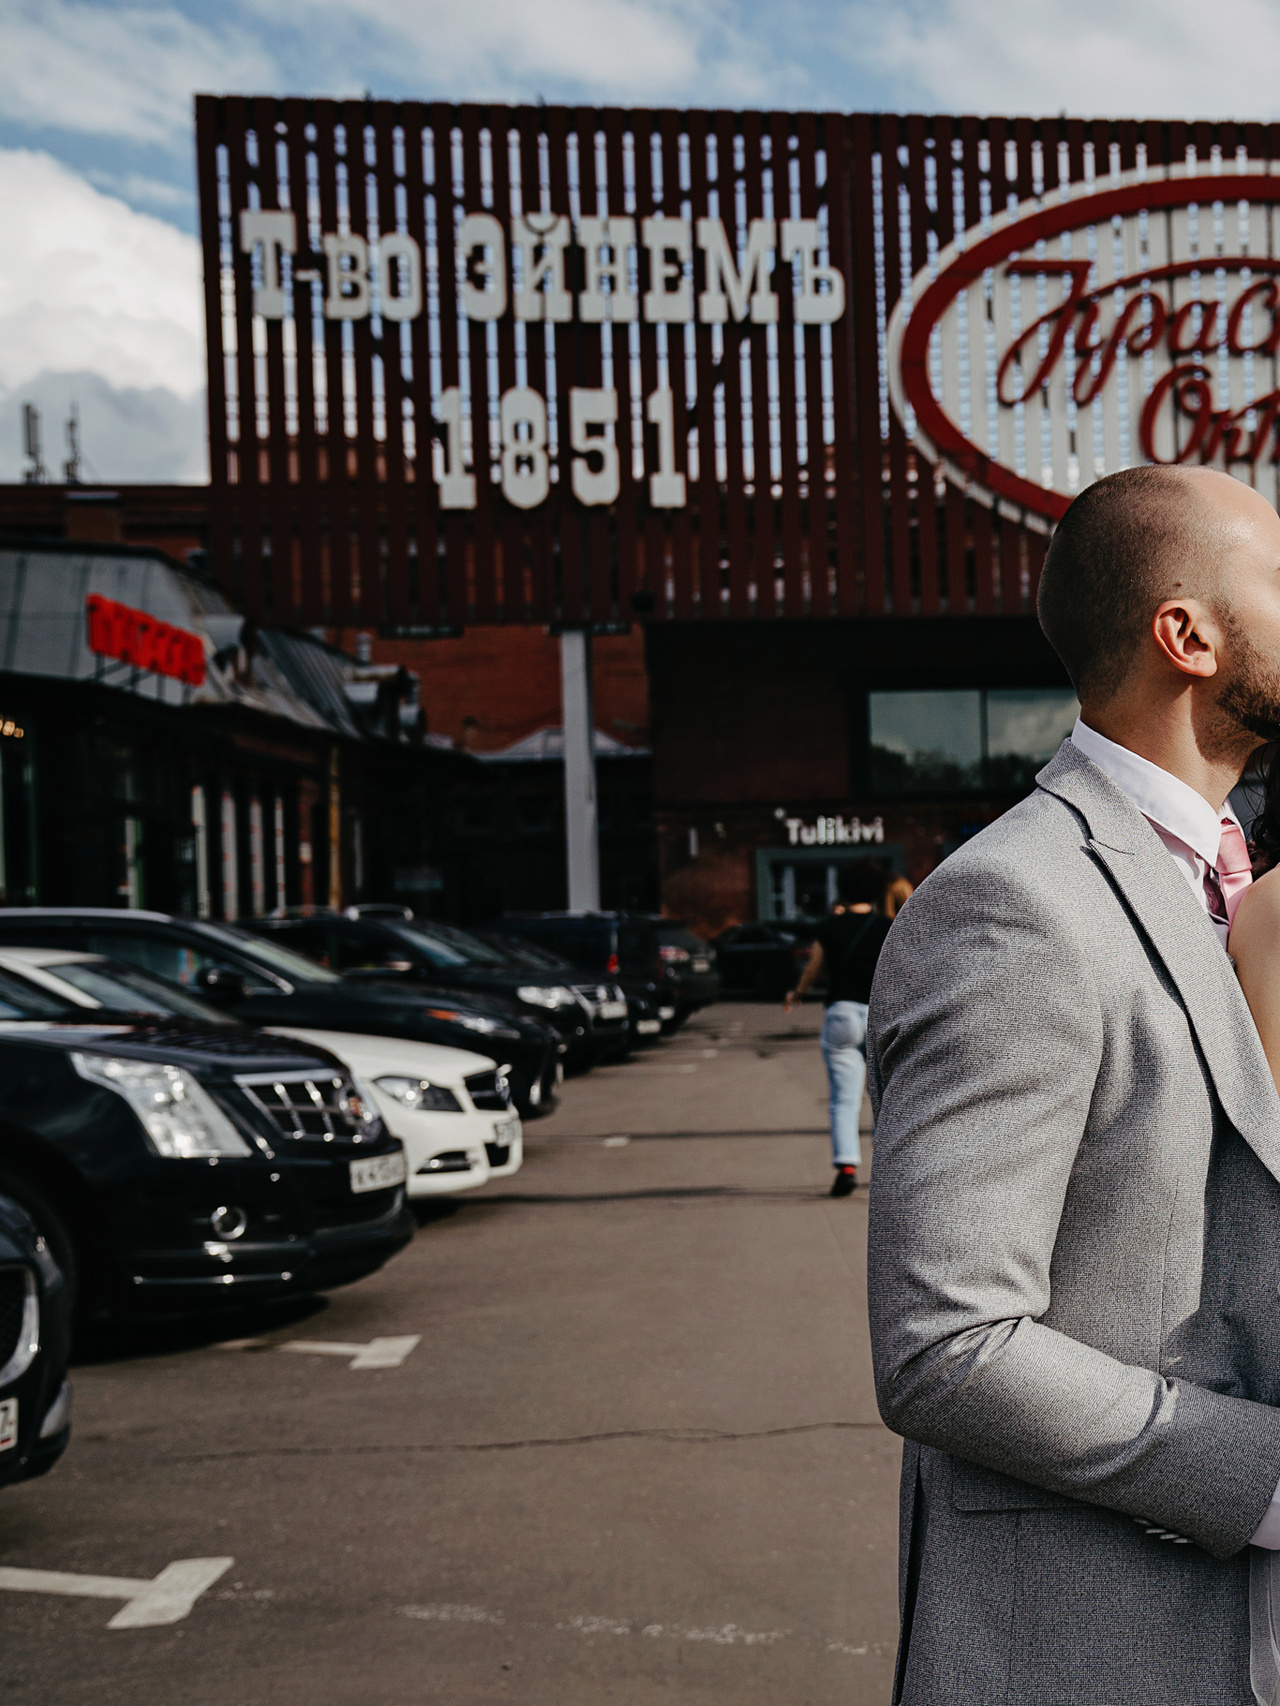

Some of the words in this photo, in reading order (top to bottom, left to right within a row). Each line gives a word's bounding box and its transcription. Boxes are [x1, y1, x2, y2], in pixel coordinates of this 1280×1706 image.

[458, 211, 846, 325] ЭЙНЕМЪ
[437, 386, 687, 509] 1851
[785, 815, 884, 845] Tulikivi
